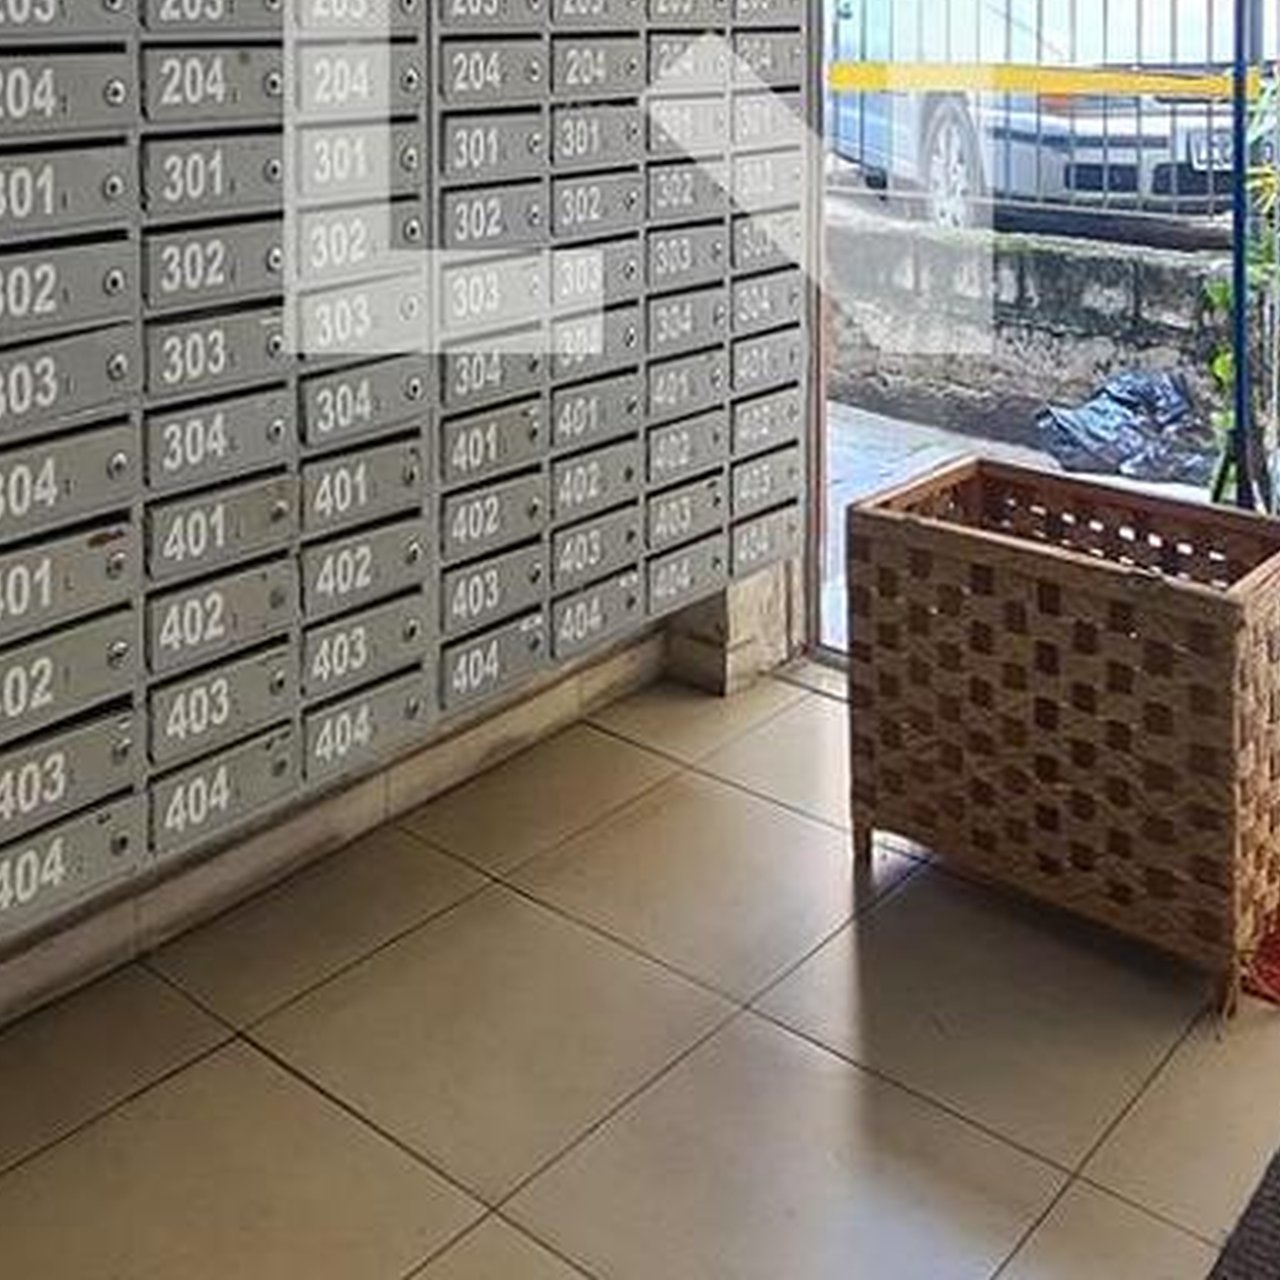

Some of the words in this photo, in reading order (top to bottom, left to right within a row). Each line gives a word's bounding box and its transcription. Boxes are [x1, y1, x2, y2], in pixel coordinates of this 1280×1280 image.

[161, 57, 225, 104] 204
[314, 59, 368, 102] 204
[453, 51, 501, 92] 204
[314, 137, 366, 183] 301
[454, 128, 498, 168] 301
[164, 150, 222, 201] 301
[311, 218, 366, 267] 302
[455, 197, 501, 241] 302
[162, 240, 224, 291] 302
[452, 271, 500, 318] 303
[316, 295, 371, 345] 303
[163, 330, 226, 383] 303
[455, 350, 501, 395] 304
[317, 380, 371, 431] 304
[163, 413, 227, 470] 304
[452, 423, 497, 469] 401
[314, 462, 369, 516] 401
[163, 504, 224, 561] 401
[452, 496, 498, 543] 402
[316, 546, 370, 596] 402
[453, 570, 498, 618] 403
[160, 592, 224, 650] 402
[312, 627, 366, 681] 403
[453, 640, 498, 693] 404
[167, 678, 230, 739] 403
[315, 704, 370, 761] 404
[165, 766, 229, 831] 404
